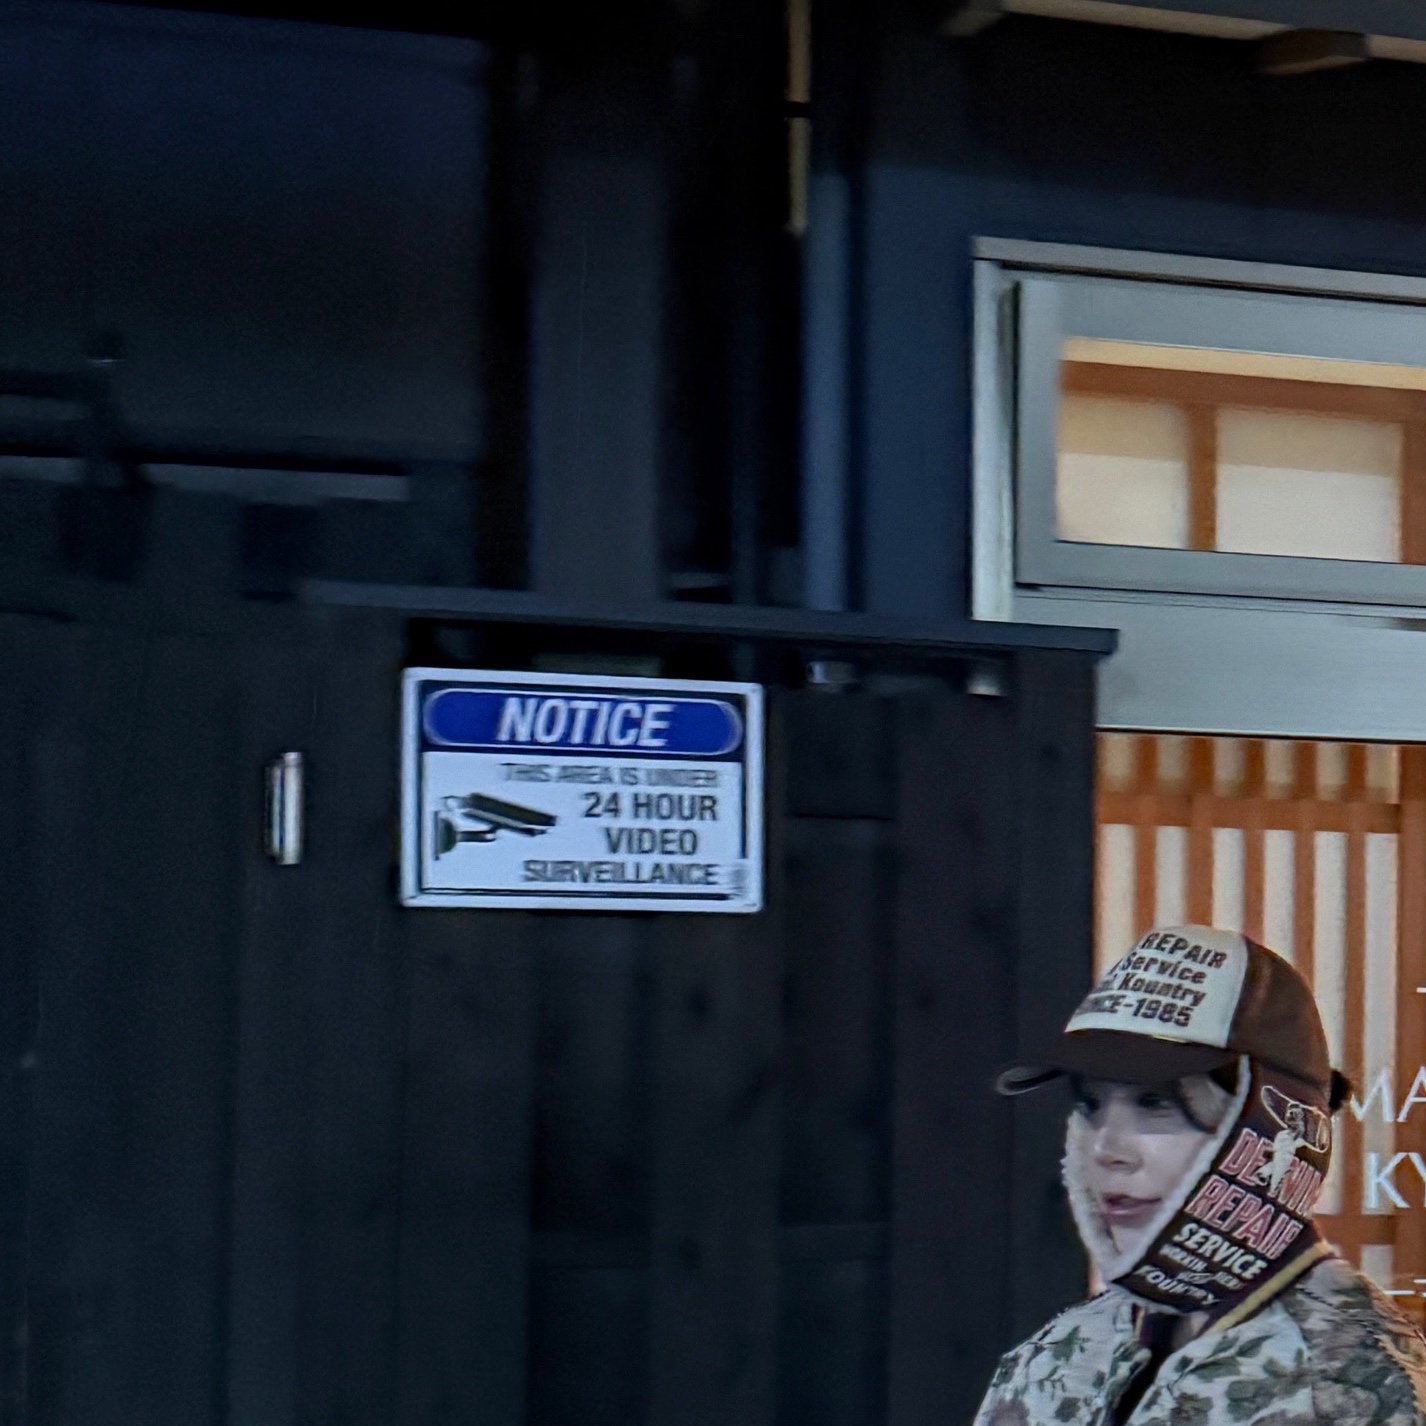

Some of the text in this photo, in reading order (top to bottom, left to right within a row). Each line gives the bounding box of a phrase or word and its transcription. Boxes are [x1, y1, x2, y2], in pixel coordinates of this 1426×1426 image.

[497, 697, 676, 748] NOTICE
[499, 762, 552, 783] THIS
[557, 765, 613, 784] AREA
[619, 767, 640, 786] IS
[583, 792, 718, 821] 24 HOUR
[605, 827, 698, 856] VIDEO
[524, 859, 720, 886] SURVEILLANCE
[1121, 951, 1207, 984] Service
[1140, 932, 1228, 969] REPAIR
[1117, 971, 1208, 1007] Kountry
[1185, 1174, 1304, 1260] REPAIR
[1172, 1222, 1268, 1280] SERVICE
